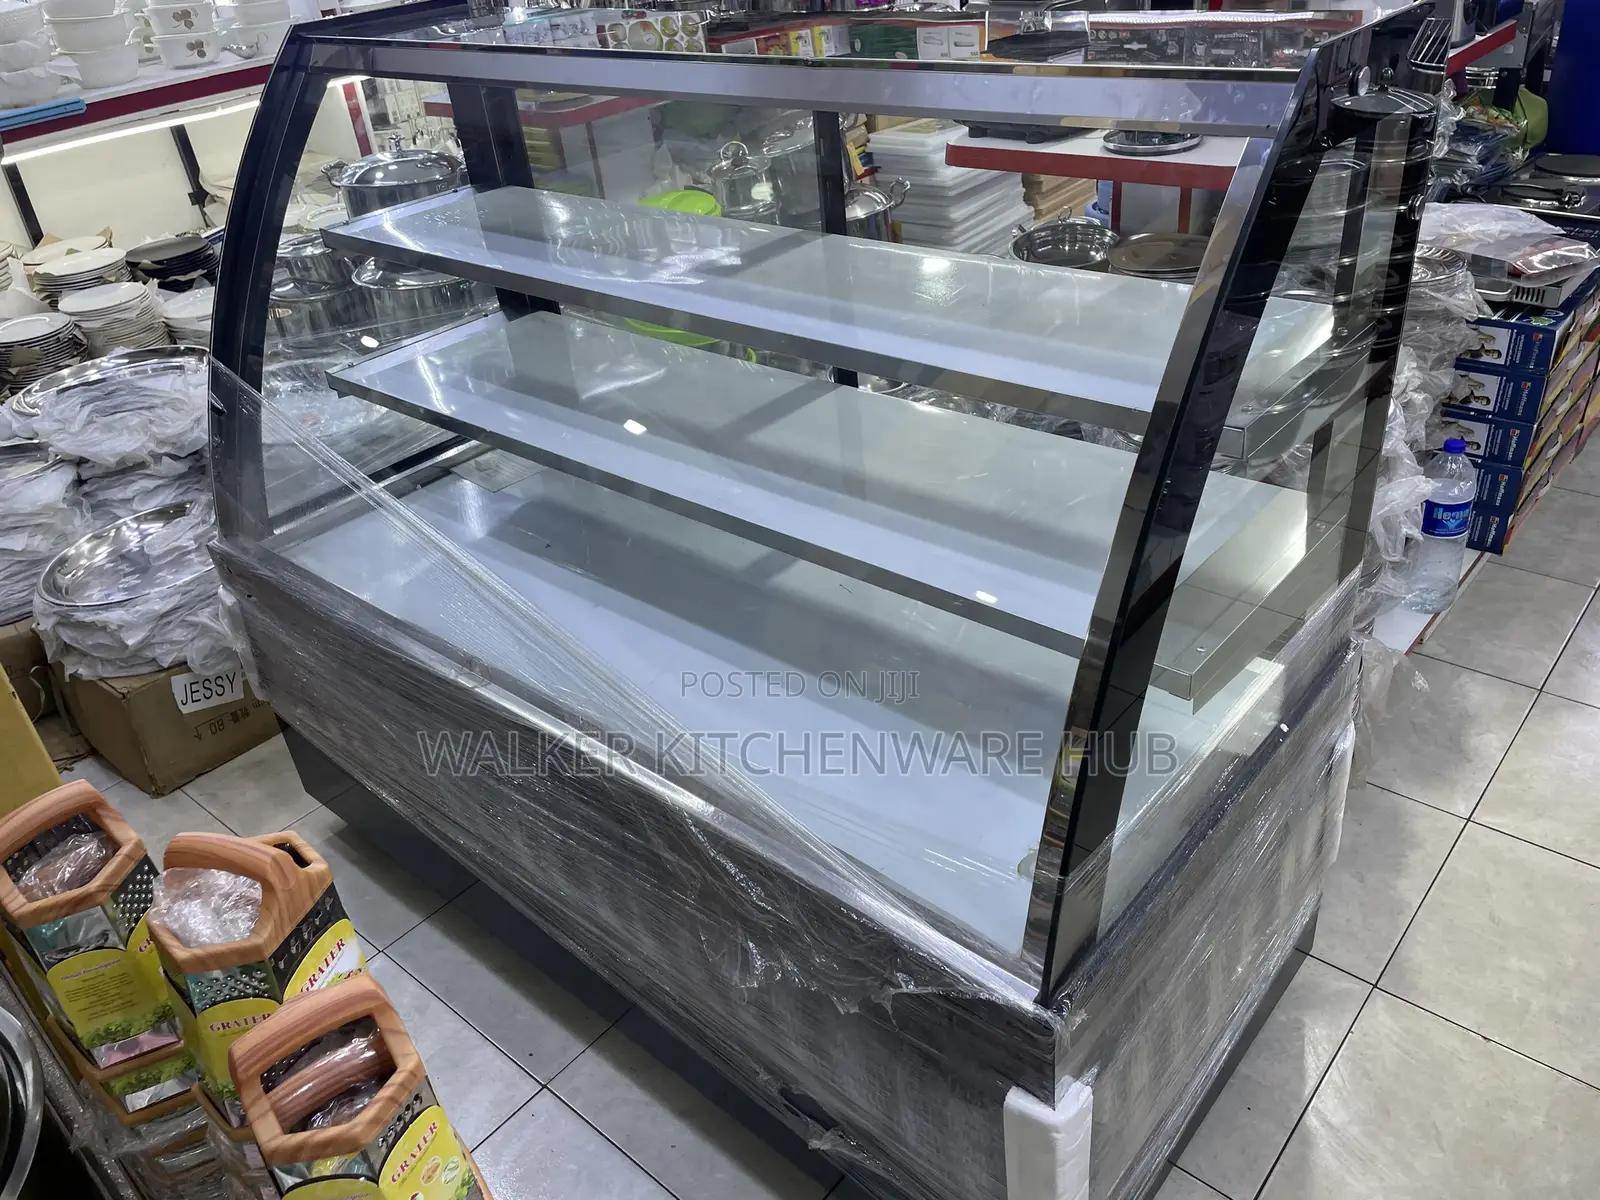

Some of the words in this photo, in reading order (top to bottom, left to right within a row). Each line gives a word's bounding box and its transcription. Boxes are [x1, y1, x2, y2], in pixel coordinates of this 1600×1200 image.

[180, 672, 236, 706] JESSY
[301, 937, 346, 993] GRATER
[209, 1012, 271, 1032] GRATER
[391, 1122, 439, 1183] GRATER
